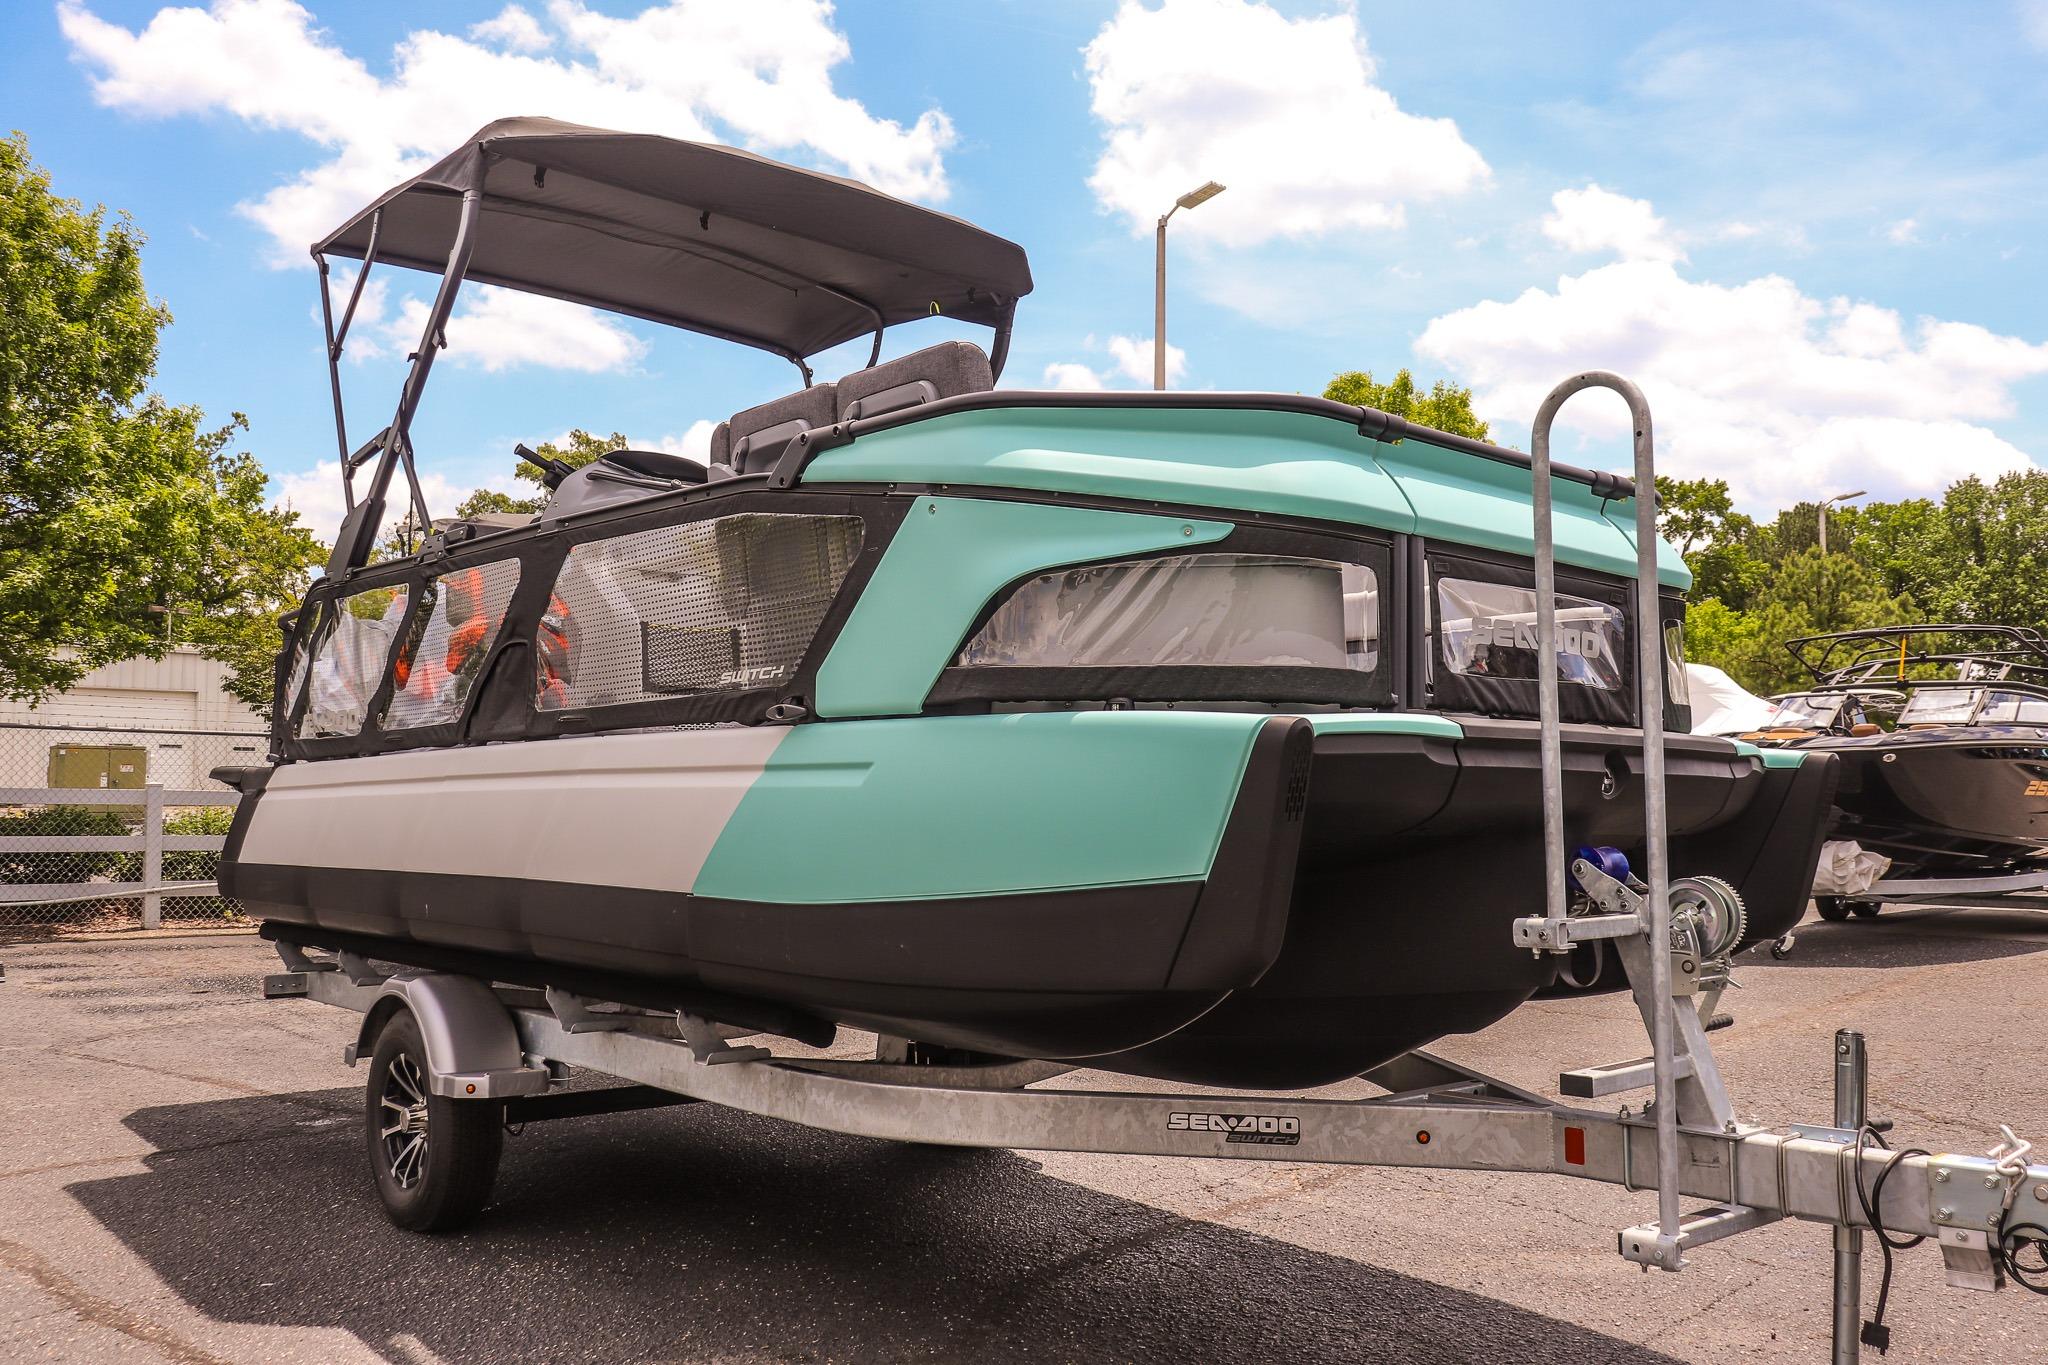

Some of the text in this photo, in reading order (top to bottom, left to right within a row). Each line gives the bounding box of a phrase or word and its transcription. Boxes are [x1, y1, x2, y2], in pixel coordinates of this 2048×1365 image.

[720, 665, 785, 684] SWITCH
[2023, 780, 2048, 796] 25
[1227, 1134, 1299, 1145] SWITCH
